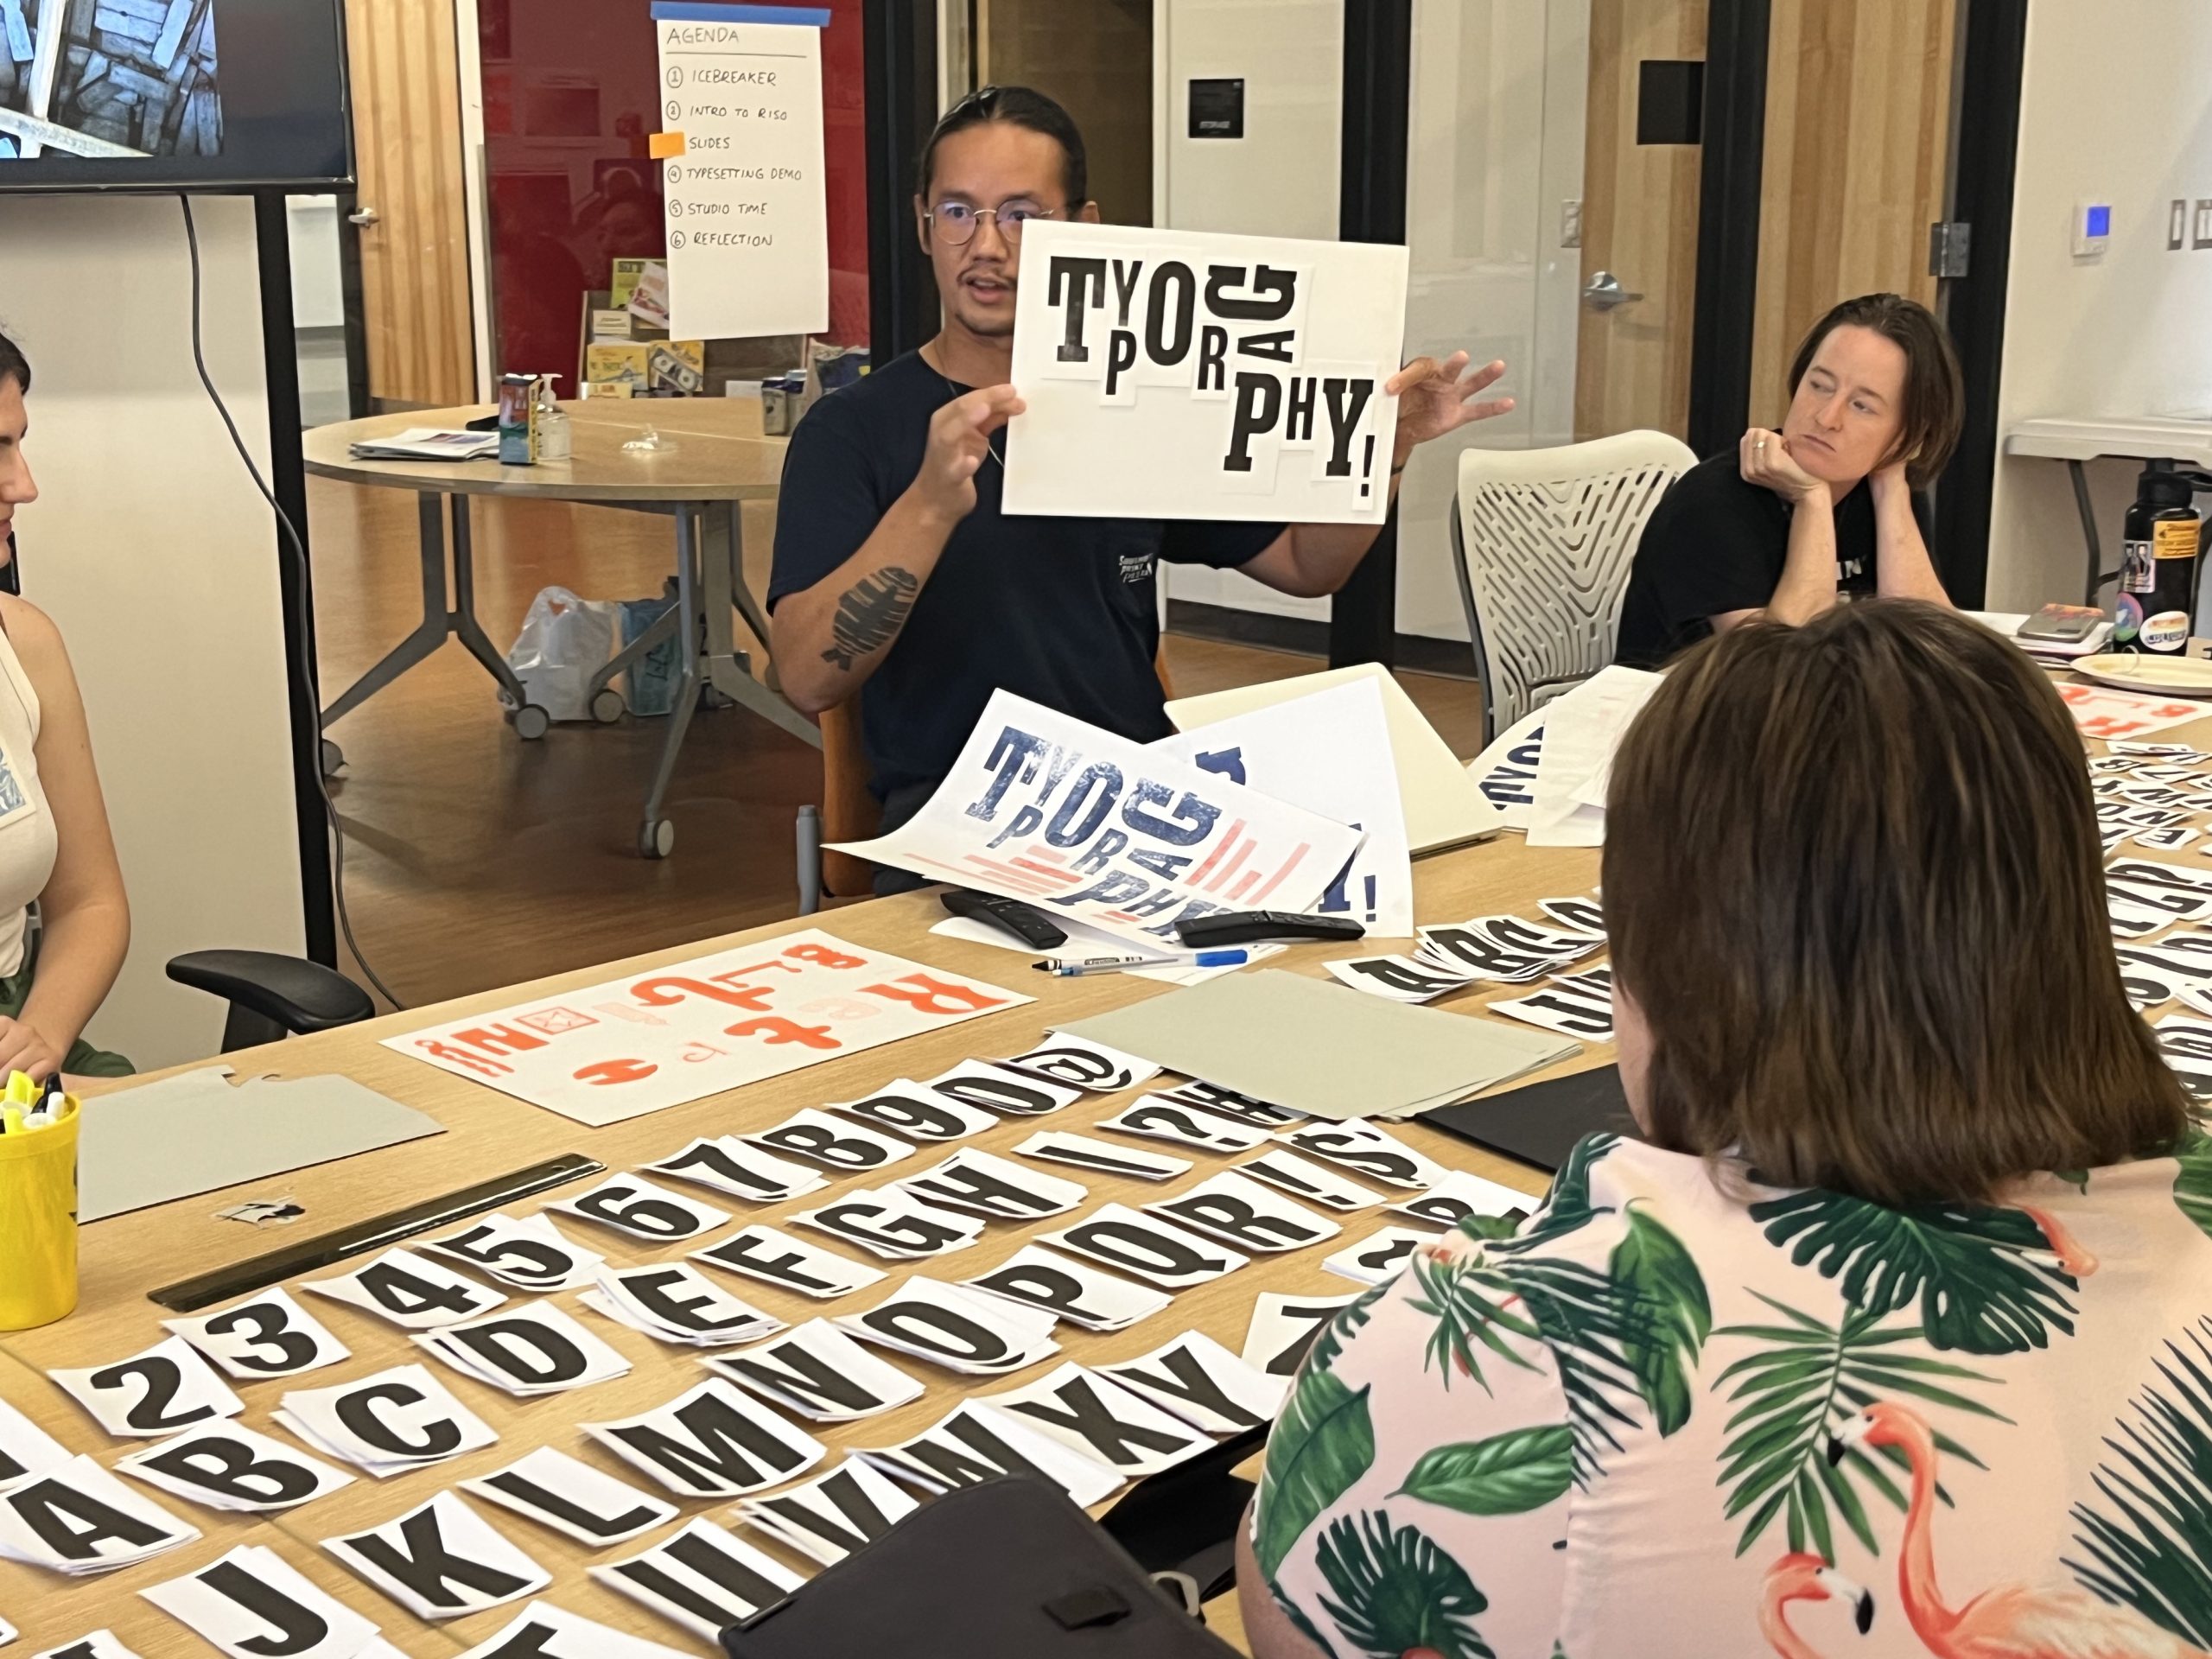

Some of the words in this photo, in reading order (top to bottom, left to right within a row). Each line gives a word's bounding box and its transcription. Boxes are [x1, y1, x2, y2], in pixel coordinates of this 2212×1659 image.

[667, 28, 740, 44] AGENDA
[692, 70, 777, 86] ICEBREAKER
[690, 106, 727, 118] INTRO
[735, 108, 748, 118] TO
[759, 108, 787, 120] RISO
[689, 137, 730, 149] SLIDES
[687, 168, 764, 180] TYPESETTING
[771, 168, 802, 181] DEMO
[688, 204, 729, 215] STUDIO
[738, 203, 767, 215] TIME
[694, 232, 772, 246] REFLECTION
[90, 1357, 217, 1430] 2
[205, 1302, 318, 1372] 3
[356, 1262, 481, 1314] 4
[432, 1225, 573, 1279] 5
[575, 1187, 700, 1236] 6
[657, 1143, 789, 1192] 7
[762, 1124, 887, 1166] 8
[851, 1096, 966, 1138] 9
[1009, 1048, 1132, 1089] @
[7, 1478, 174, 1560] A
[138, 1437, 318, 1503] B
[335, 1383, 461, 1456] C
[449, 1319, 587, 1383] D
[618, 1269, 760, 1331] E
[704, 1235, 836, 1291] F
[815, 1204, 967, 1252] G
[948, 1163, 1065, 1214] H
[1121, 1107, 1250, 1147] ?
[195, 1560, 328, 1656] J
[343, 1504, 533, 1607] K
[482, 1471, 662, 1537] L
[606, 1392, 807, 1491] M
[715, 1341, 885, 1412] N
[862, 1301, 1007, 1361] O
[974, 1265, 1112, 1320] P
[1064, 1220, 1226, 1275] Q
[1159, 1193, 1321, 1247] R
[1243, 1161, 1357, 1205] !
[1003, 1375, 1195, 1465] X
[1103, 1345, 1266, 1427] Y
